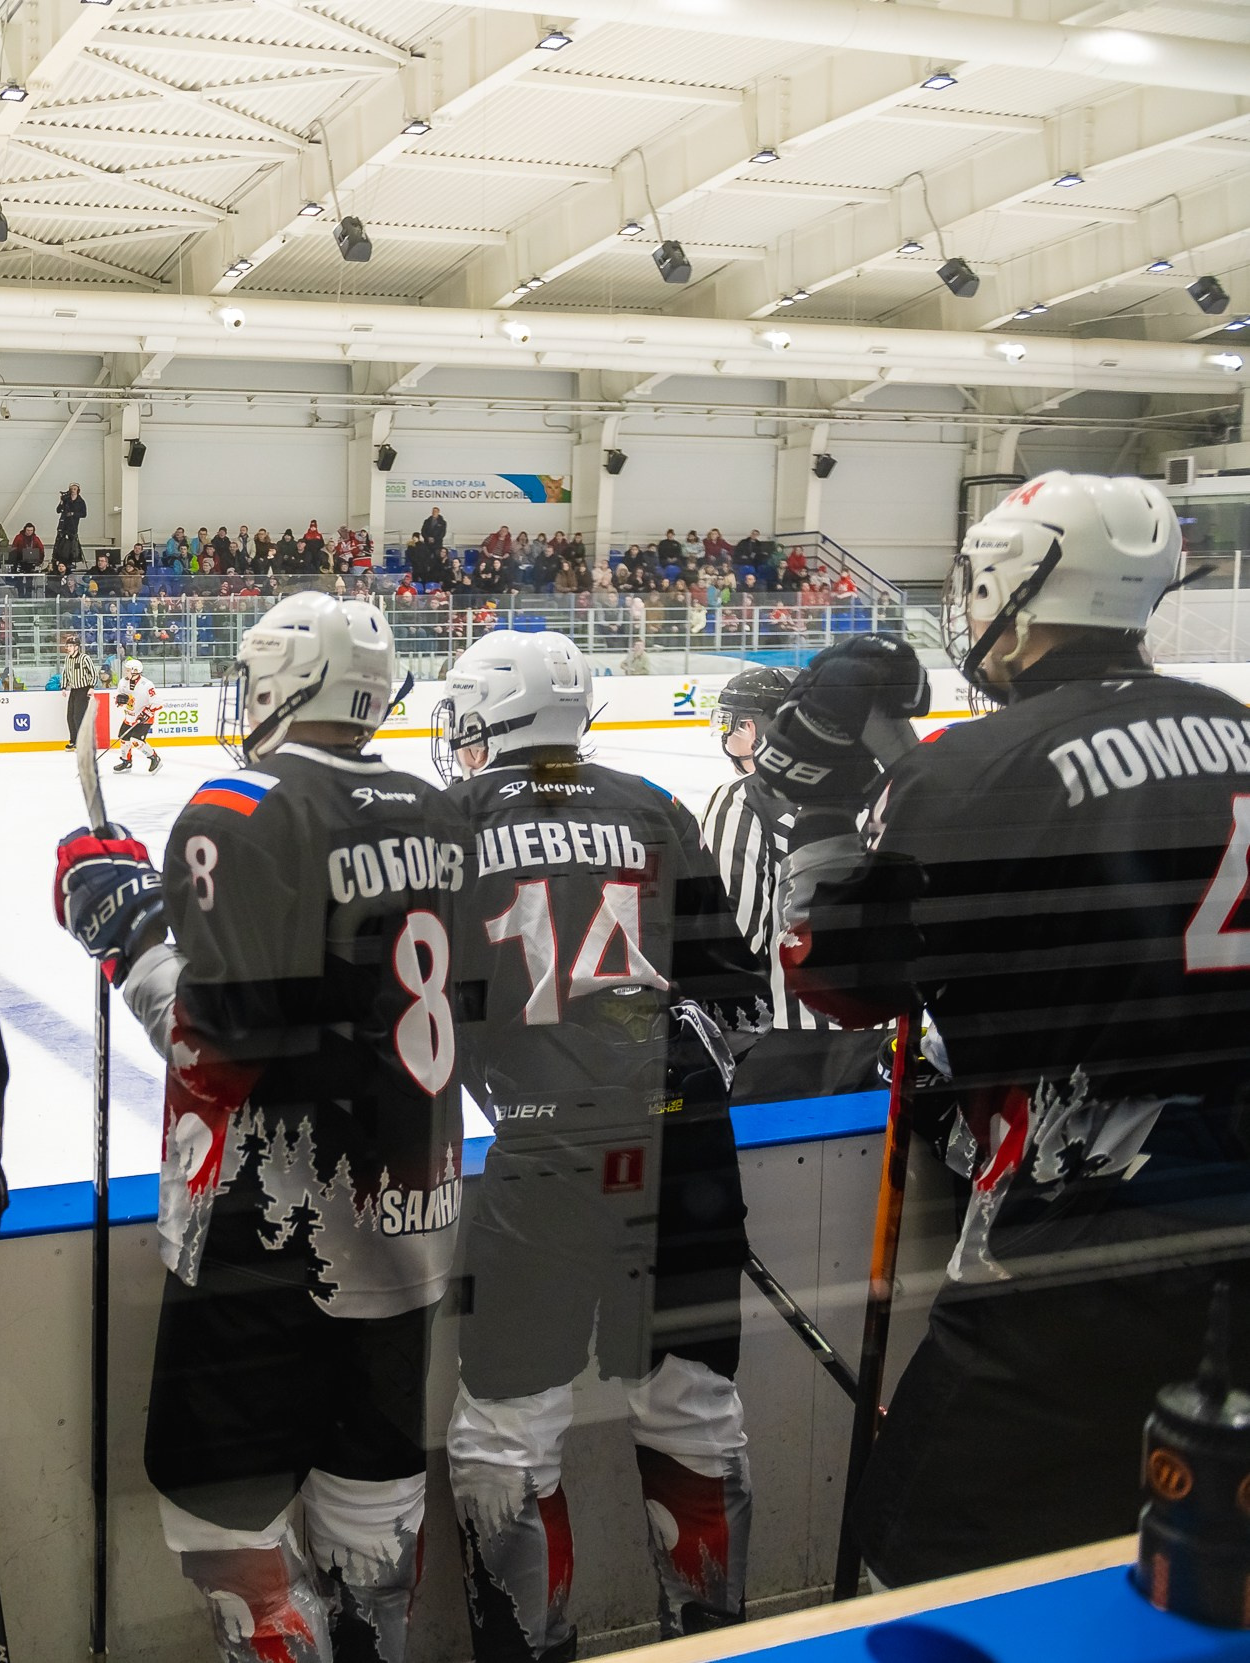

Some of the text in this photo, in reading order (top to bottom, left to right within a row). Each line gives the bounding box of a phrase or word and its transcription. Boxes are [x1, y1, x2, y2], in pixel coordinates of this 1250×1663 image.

[412, 490, 467, 499] BEGINNING
[469, 490, 482, 499] OF
[158, 710, 199, 725] 2023
[350, 690, 372, 720] 10
[531, 781, 595, 796] keeper
[1047, 716, 1250, 809] ЛОМОВ
[184, 835, 219, 911] 8
[328, 835, 465, 904] СОБОЛВ
[83, 872, 164, 943] AUER
[485, 879, 671, 1026] 14
[393, 909, 456, 1096] 8
